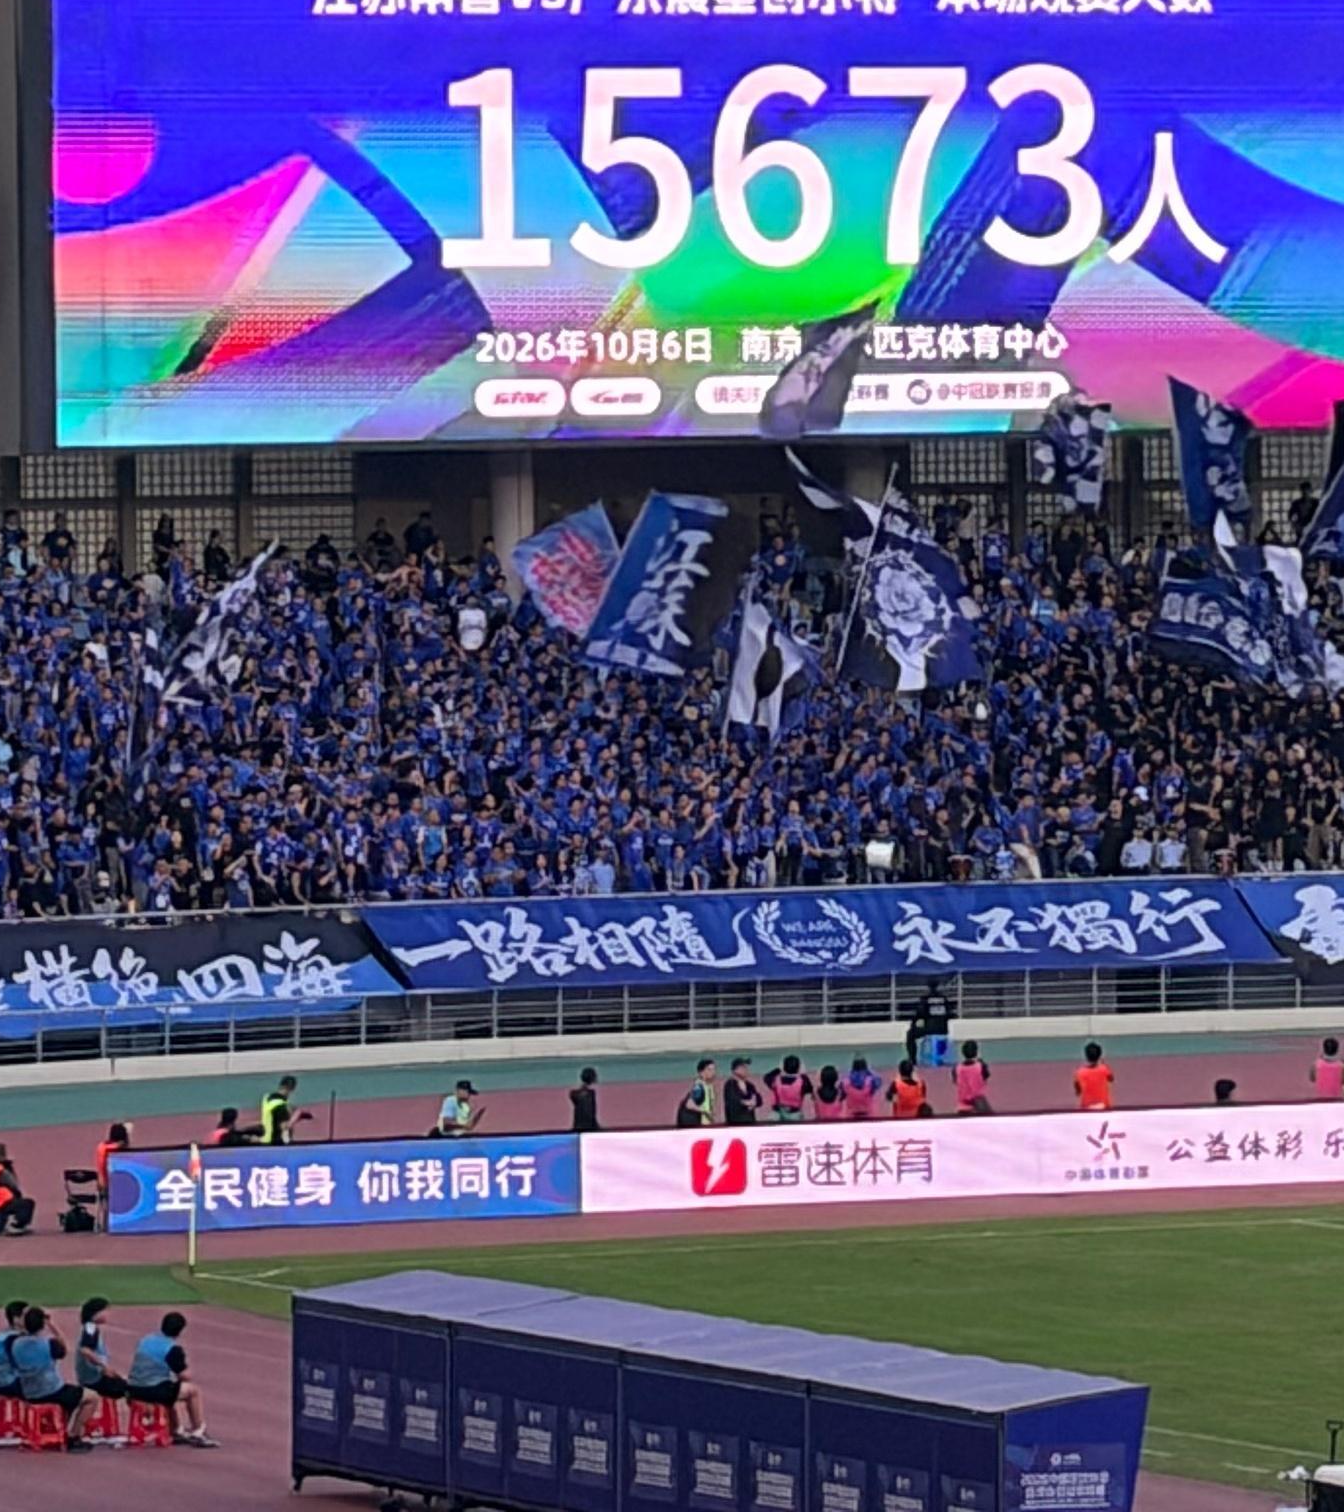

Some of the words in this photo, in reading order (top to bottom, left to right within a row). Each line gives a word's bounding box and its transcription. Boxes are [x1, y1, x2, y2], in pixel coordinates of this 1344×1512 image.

[441, 65, 1229, 271] 15673人
[475, 327, 713, 365] 2026年10月6日
[741, 322, 1069, 363] 南京匹克体育中心
[757, 1138, 935, 1188] 雷速体育
[1165, 1129, 1305, 1164] 公益体彩
[156, 1165, 337, 1212] 全民健身
[358, 1154, 537, 1204] 你我同行
